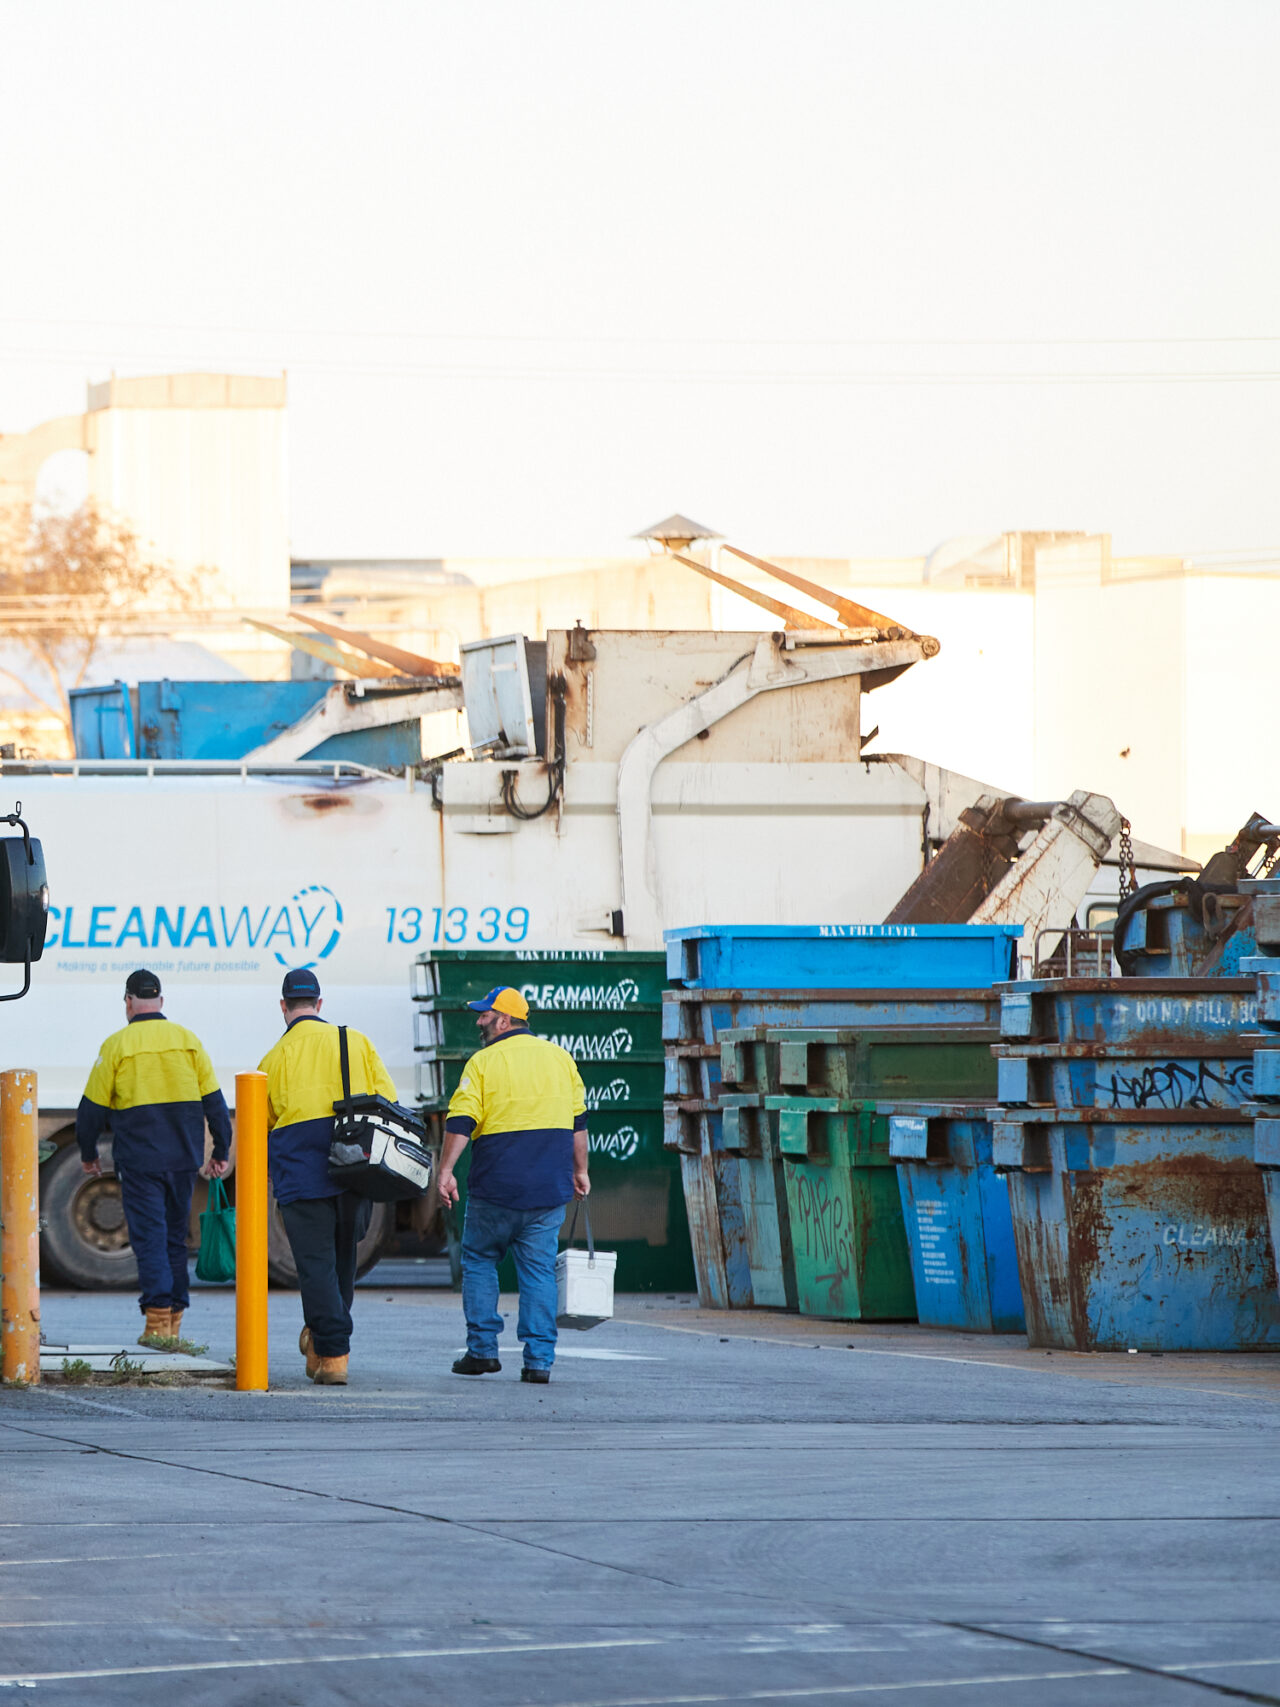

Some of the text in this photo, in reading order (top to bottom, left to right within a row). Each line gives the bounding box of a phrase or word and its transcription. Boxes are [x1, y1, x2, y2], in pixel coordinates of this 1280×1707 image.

[42, 905, 326, 949] CLEANAWAY
[819, 926, 917, 936] MAX FILL LEVEL
[56, 961, 97, 973] Making
[100, 963, 107, 971] a
[177, 961, 211, 973] future
[214, 961, 260, 973] possible
[520, 984, 632, 1001] CLEANAWAY
[1136, 1001, 1157, 1023] DO
[1196, 1001, 1225, 1024] FILL
